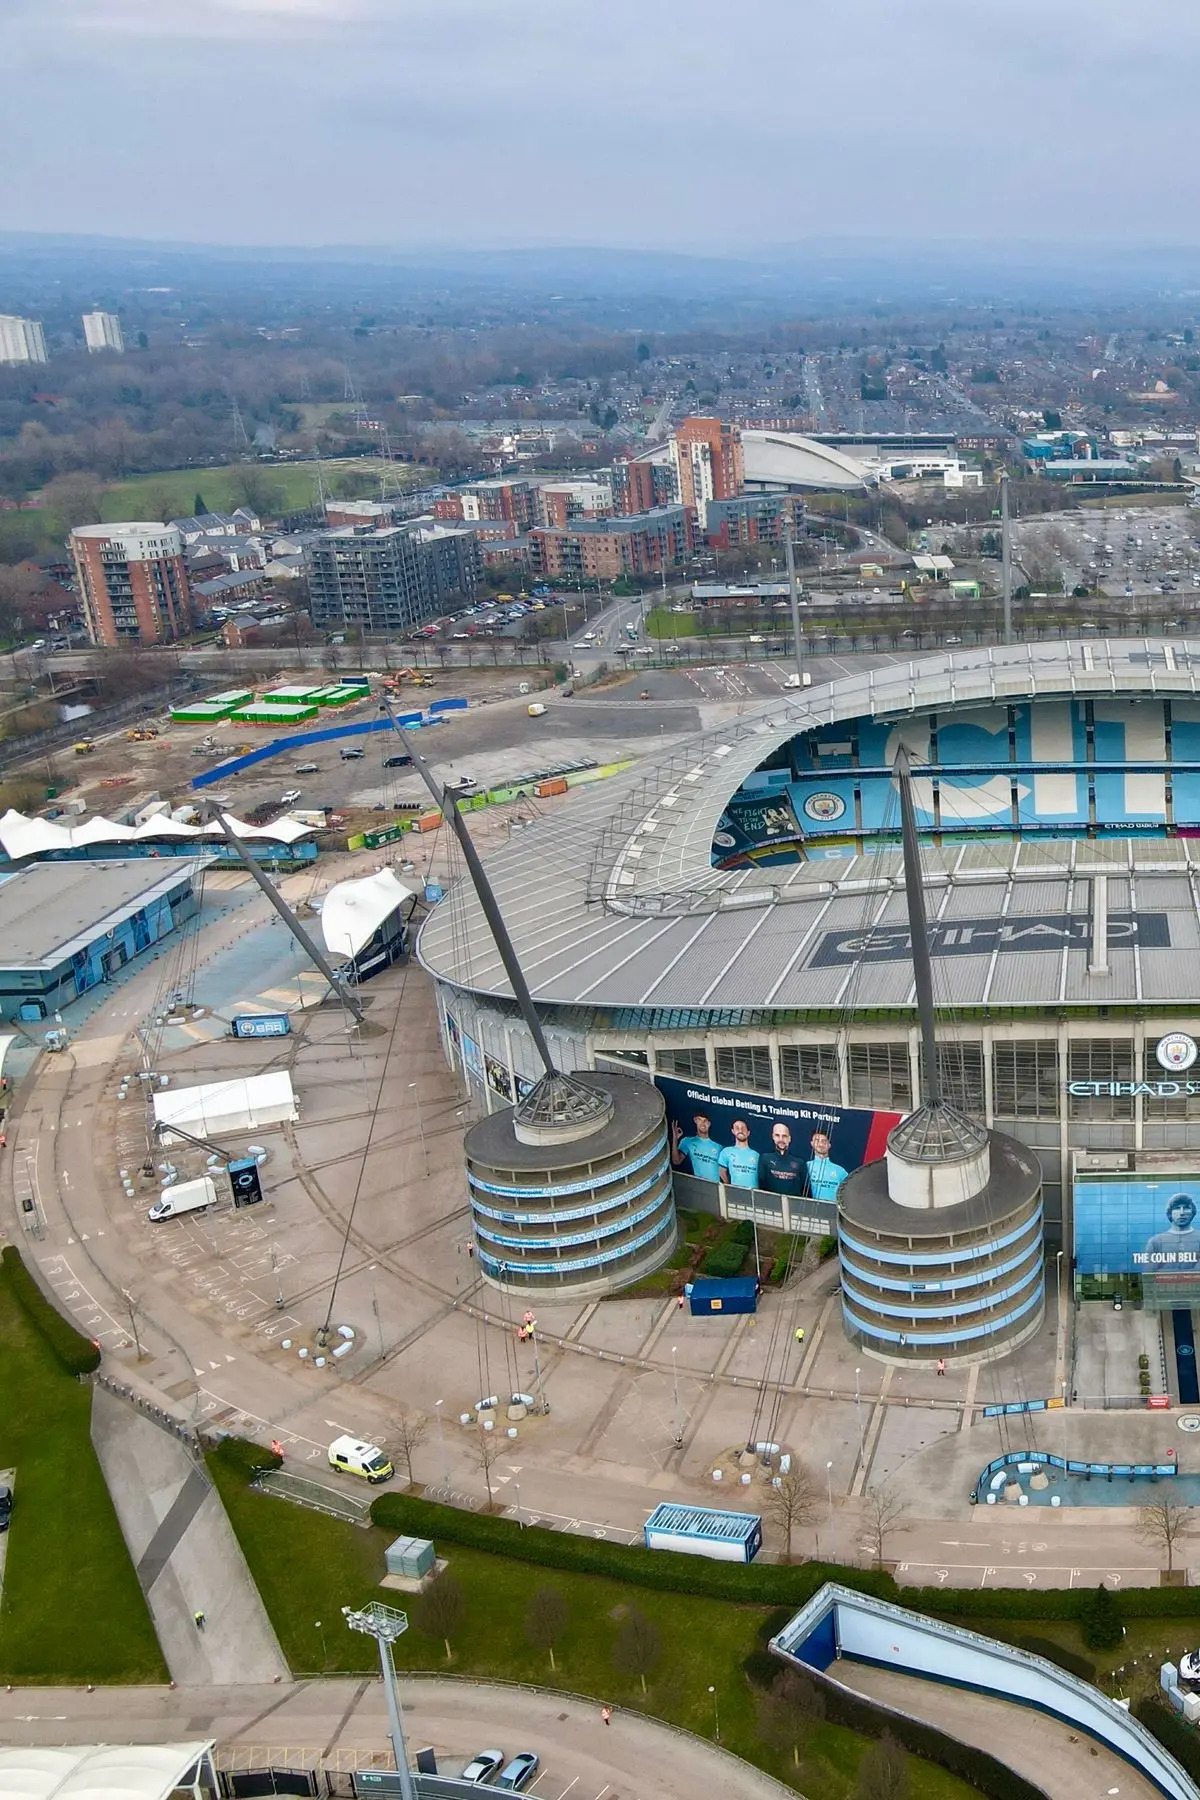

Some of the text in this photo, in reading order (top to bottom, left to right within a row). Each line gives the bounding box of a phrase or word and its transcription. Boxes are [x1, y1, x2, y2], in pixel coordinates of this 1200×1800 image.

[744, 822, 766, 832] END
[1161, 1035, 1194, 1047] MANCHESTER
[1069, 1082, 1180, 1096] ETIHAD
[687, 1089, 710, 1102] Official
[711, 1095, 734, 1107] Global
[735, 1100, 761, 1113] Betting
[768, 1105, 799, 1118] Training
[800, 1110, 811, 1118] Kit
[812, 1112, 841, 1123] Partner
[1133, 1252, 1150, 1264] THE
[1151, 1252, 1177, 1264] COLIN
[1178, 1252, 1198, 1264] BELL
